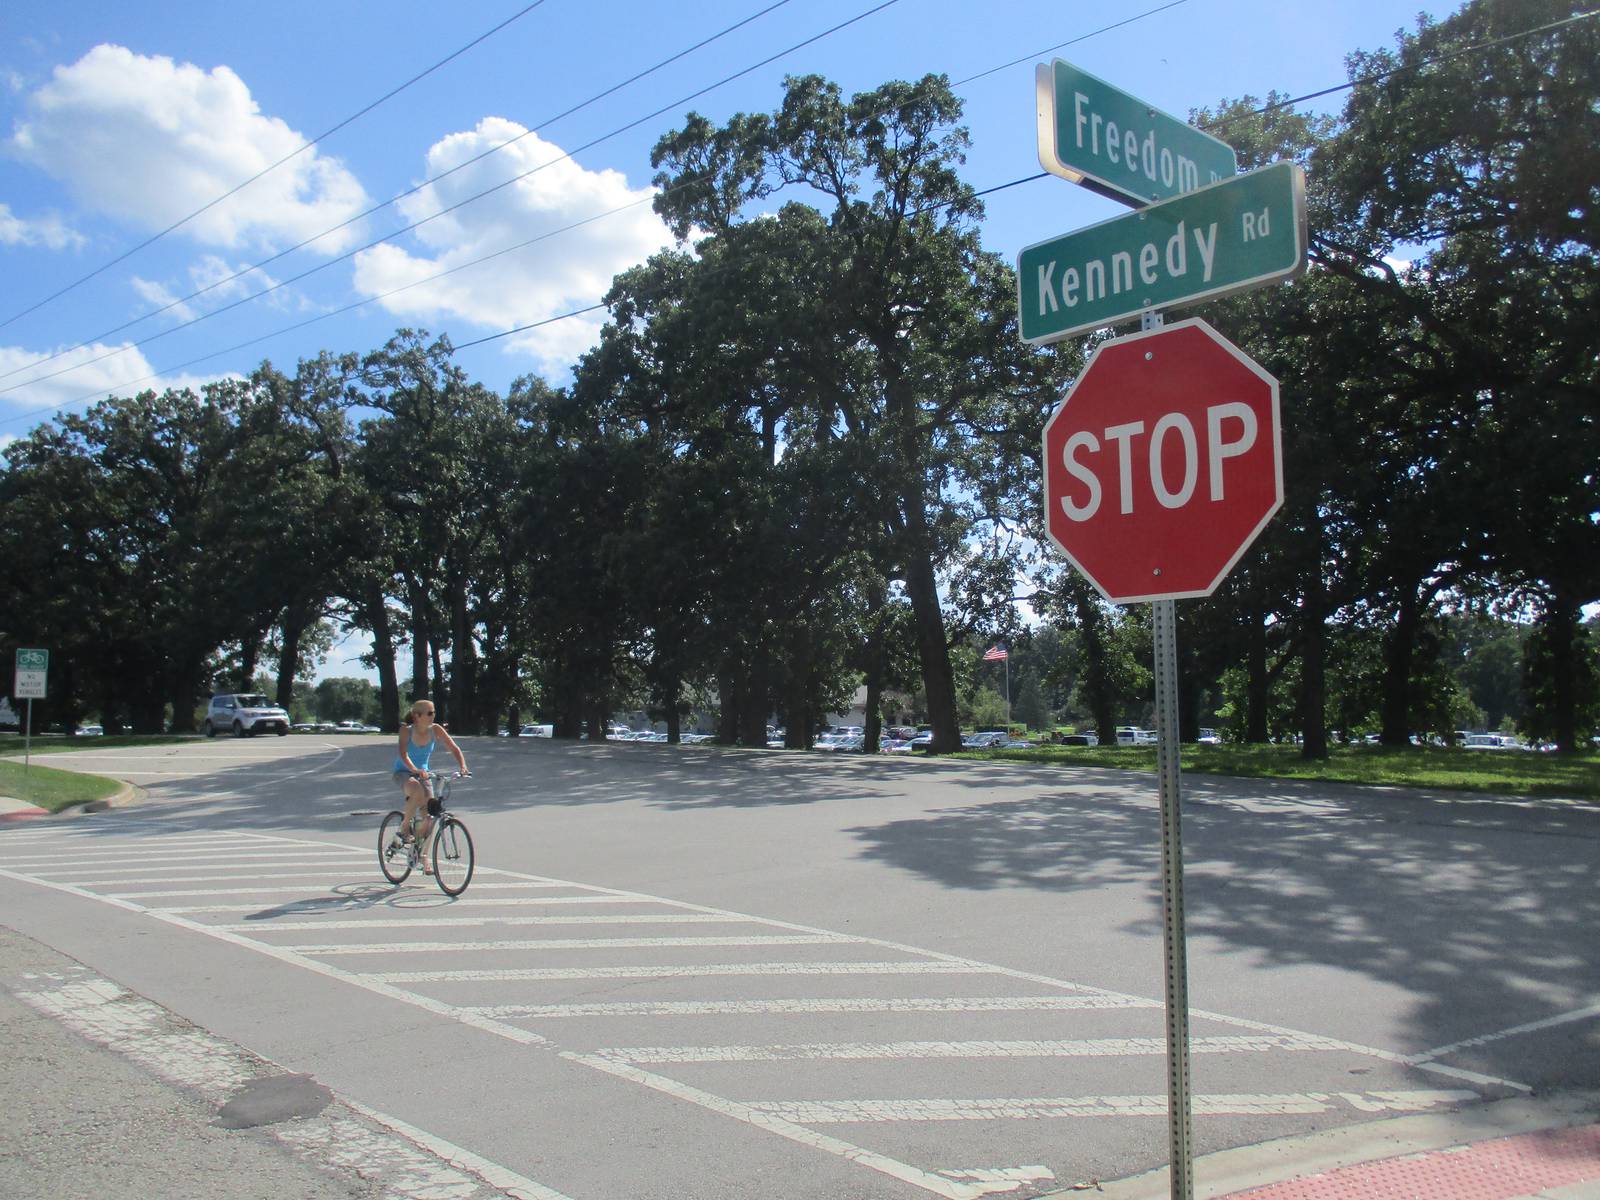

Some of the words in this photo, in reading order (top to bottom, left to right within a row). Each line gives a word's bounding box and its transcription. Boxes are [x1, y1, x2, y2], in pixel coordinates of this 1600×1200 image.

[1074, 92, 1198, 193] Freedom
[1038, 221, 1218, 316] Kennedy
[1242, 208, 1270, 242] Rd
[1061, 401, 1258, 522] STOP
